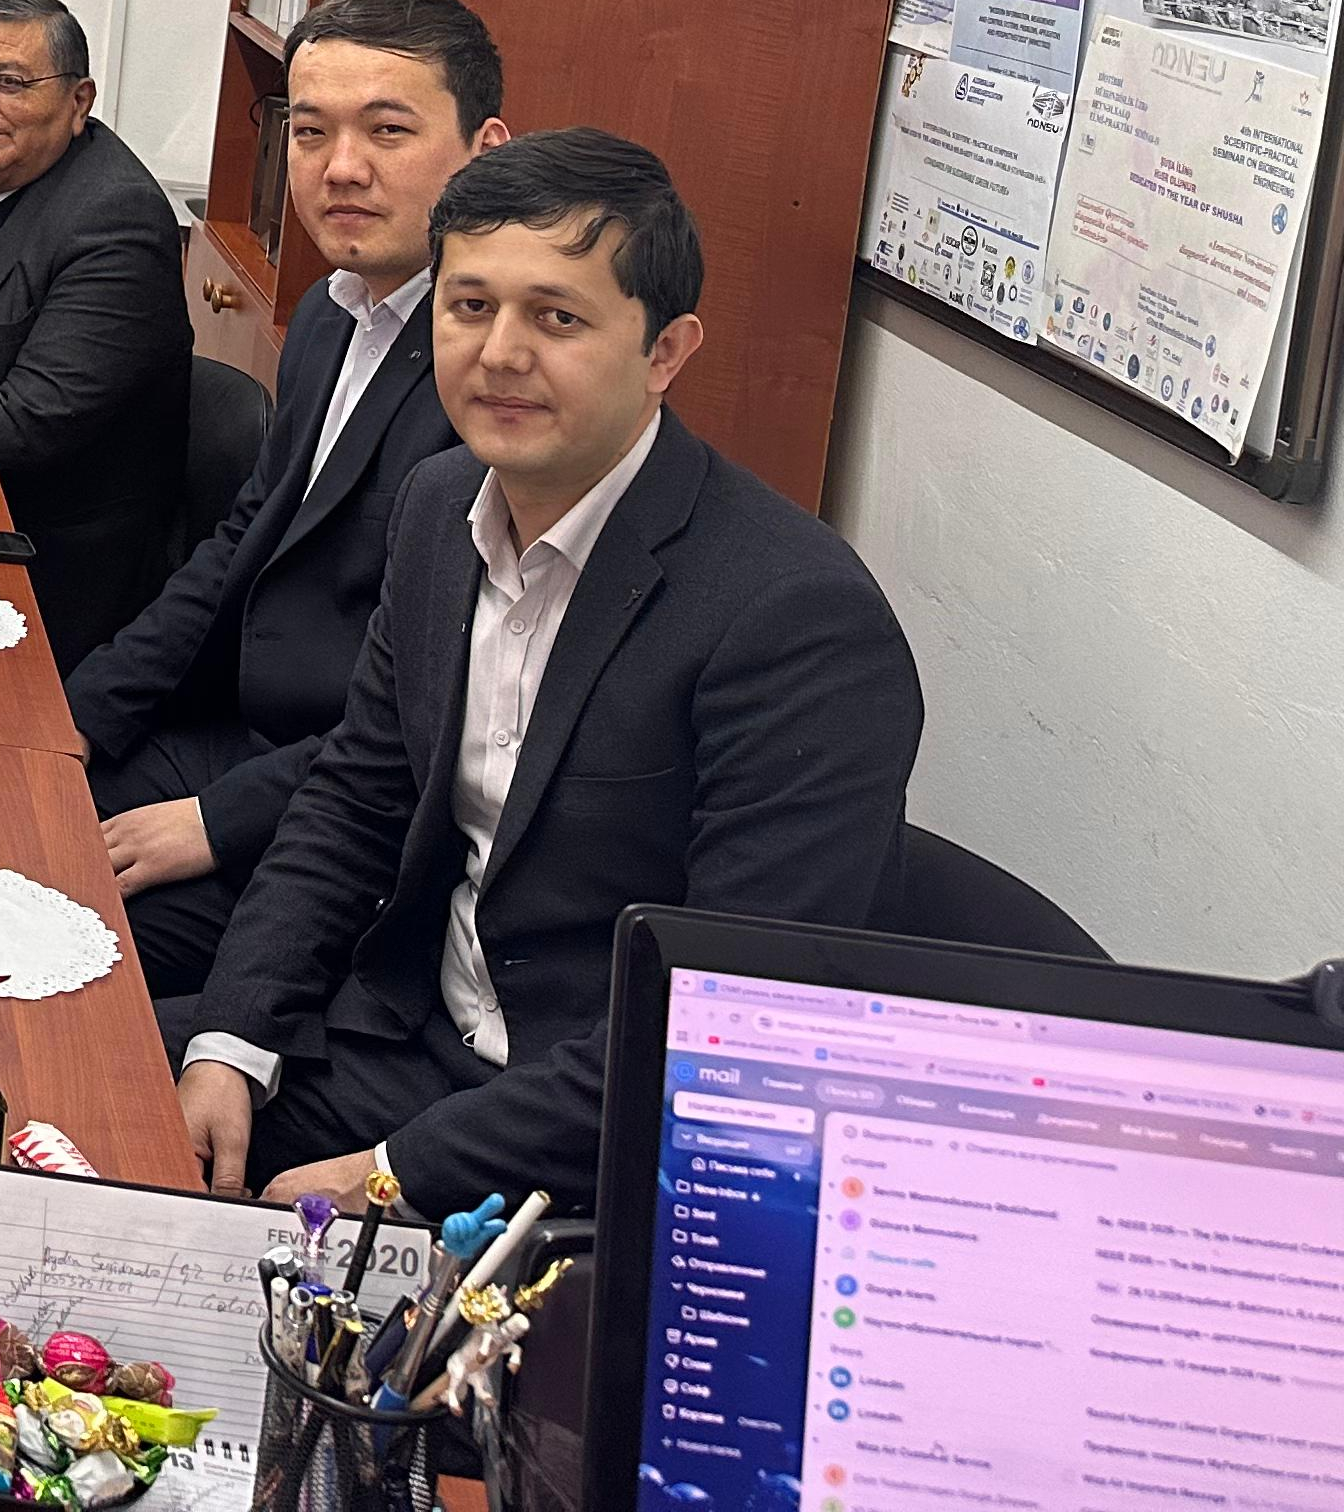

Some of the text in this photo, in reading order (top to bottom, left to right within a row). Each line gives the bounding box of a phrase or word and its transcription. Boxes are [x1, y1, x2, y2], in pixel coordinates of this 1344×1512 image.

[1224, 135, 1299, 168] SCIENTIFIC-PRACTICAL
[1253, 128, 1303, 154] INTERNATIONAL
[1213, 147, 1296, 183] SEMINAR ON BIOMEDICAL
[1253, 175, 1295, 198] ENGINEERING
[1166, 188, 1179, 202] THE
[1180, 192, 1199, 210] YEAR
[1199, 199, 1211, 213] OF
[1211, 205, 1244, 226] SHUSHA
[699, 1064, 741, 1085] mail
[268, 1227, 333, 1251] FEVL
[168, 1451, 195, 1472] 13
